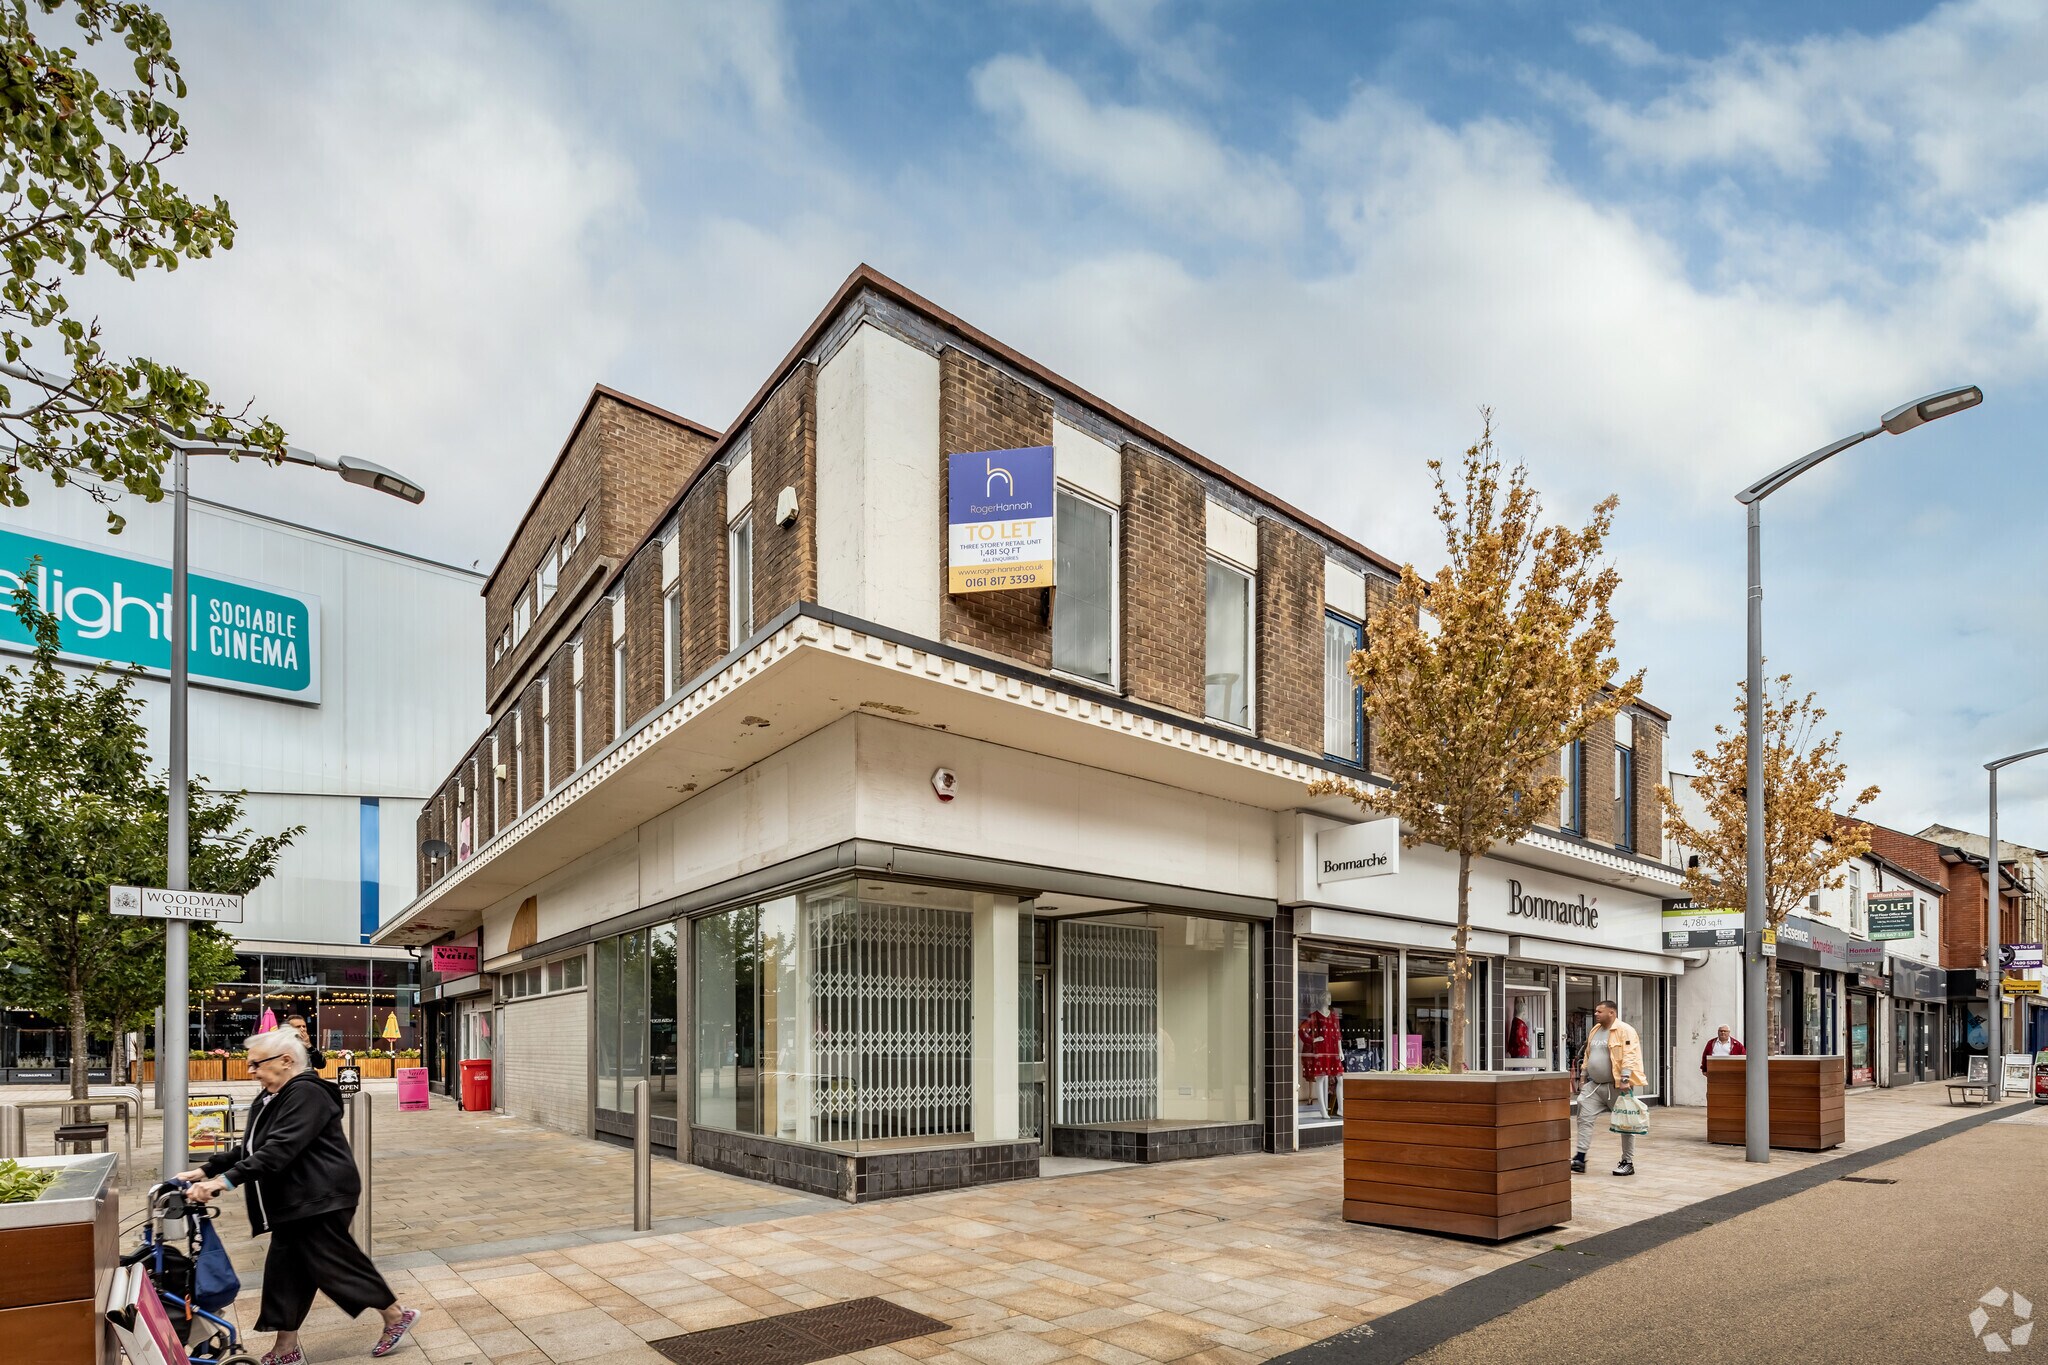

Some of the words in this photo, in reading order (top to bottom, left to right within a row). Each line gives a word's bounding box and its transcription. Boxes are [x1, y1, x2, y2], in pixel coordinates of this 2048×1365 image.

[970, 501, 1032, 515] RogerHannah
[965, 524, 995, 541] TO
[1000, 521, 1036, 539] LET
[980, 541, 1004, 549] STOREY
[999, 547, 1010, 556] SQ
[1011, 546, 1021, 554] FT
[958, 563, 1044, 576] www.roger-hannah.co.uk
[966, 577, 987, 588] 0161
[990, 576, 1007, 586] 817
[1010, 574, 1036, 585] 3399
[209, 598, 297, 639] SOCIABLE
[209, 625, 299, 671] CINEMA
[1323, 853, 1388, 873] Bonmarché
[147, 892, 238, 908] WOODMAN
[1507, 879, 1599, 929] Bonmarché
[164, 905, 222, 919] STREET
[1869, 904, 1887, 912] TO
[1891, 903, 1912, 911] LET
[1682, 918, 1707, 928] 4,780
[1784, 924, 1808, 943] Essence
[435, 951, 475, 960] Nails
